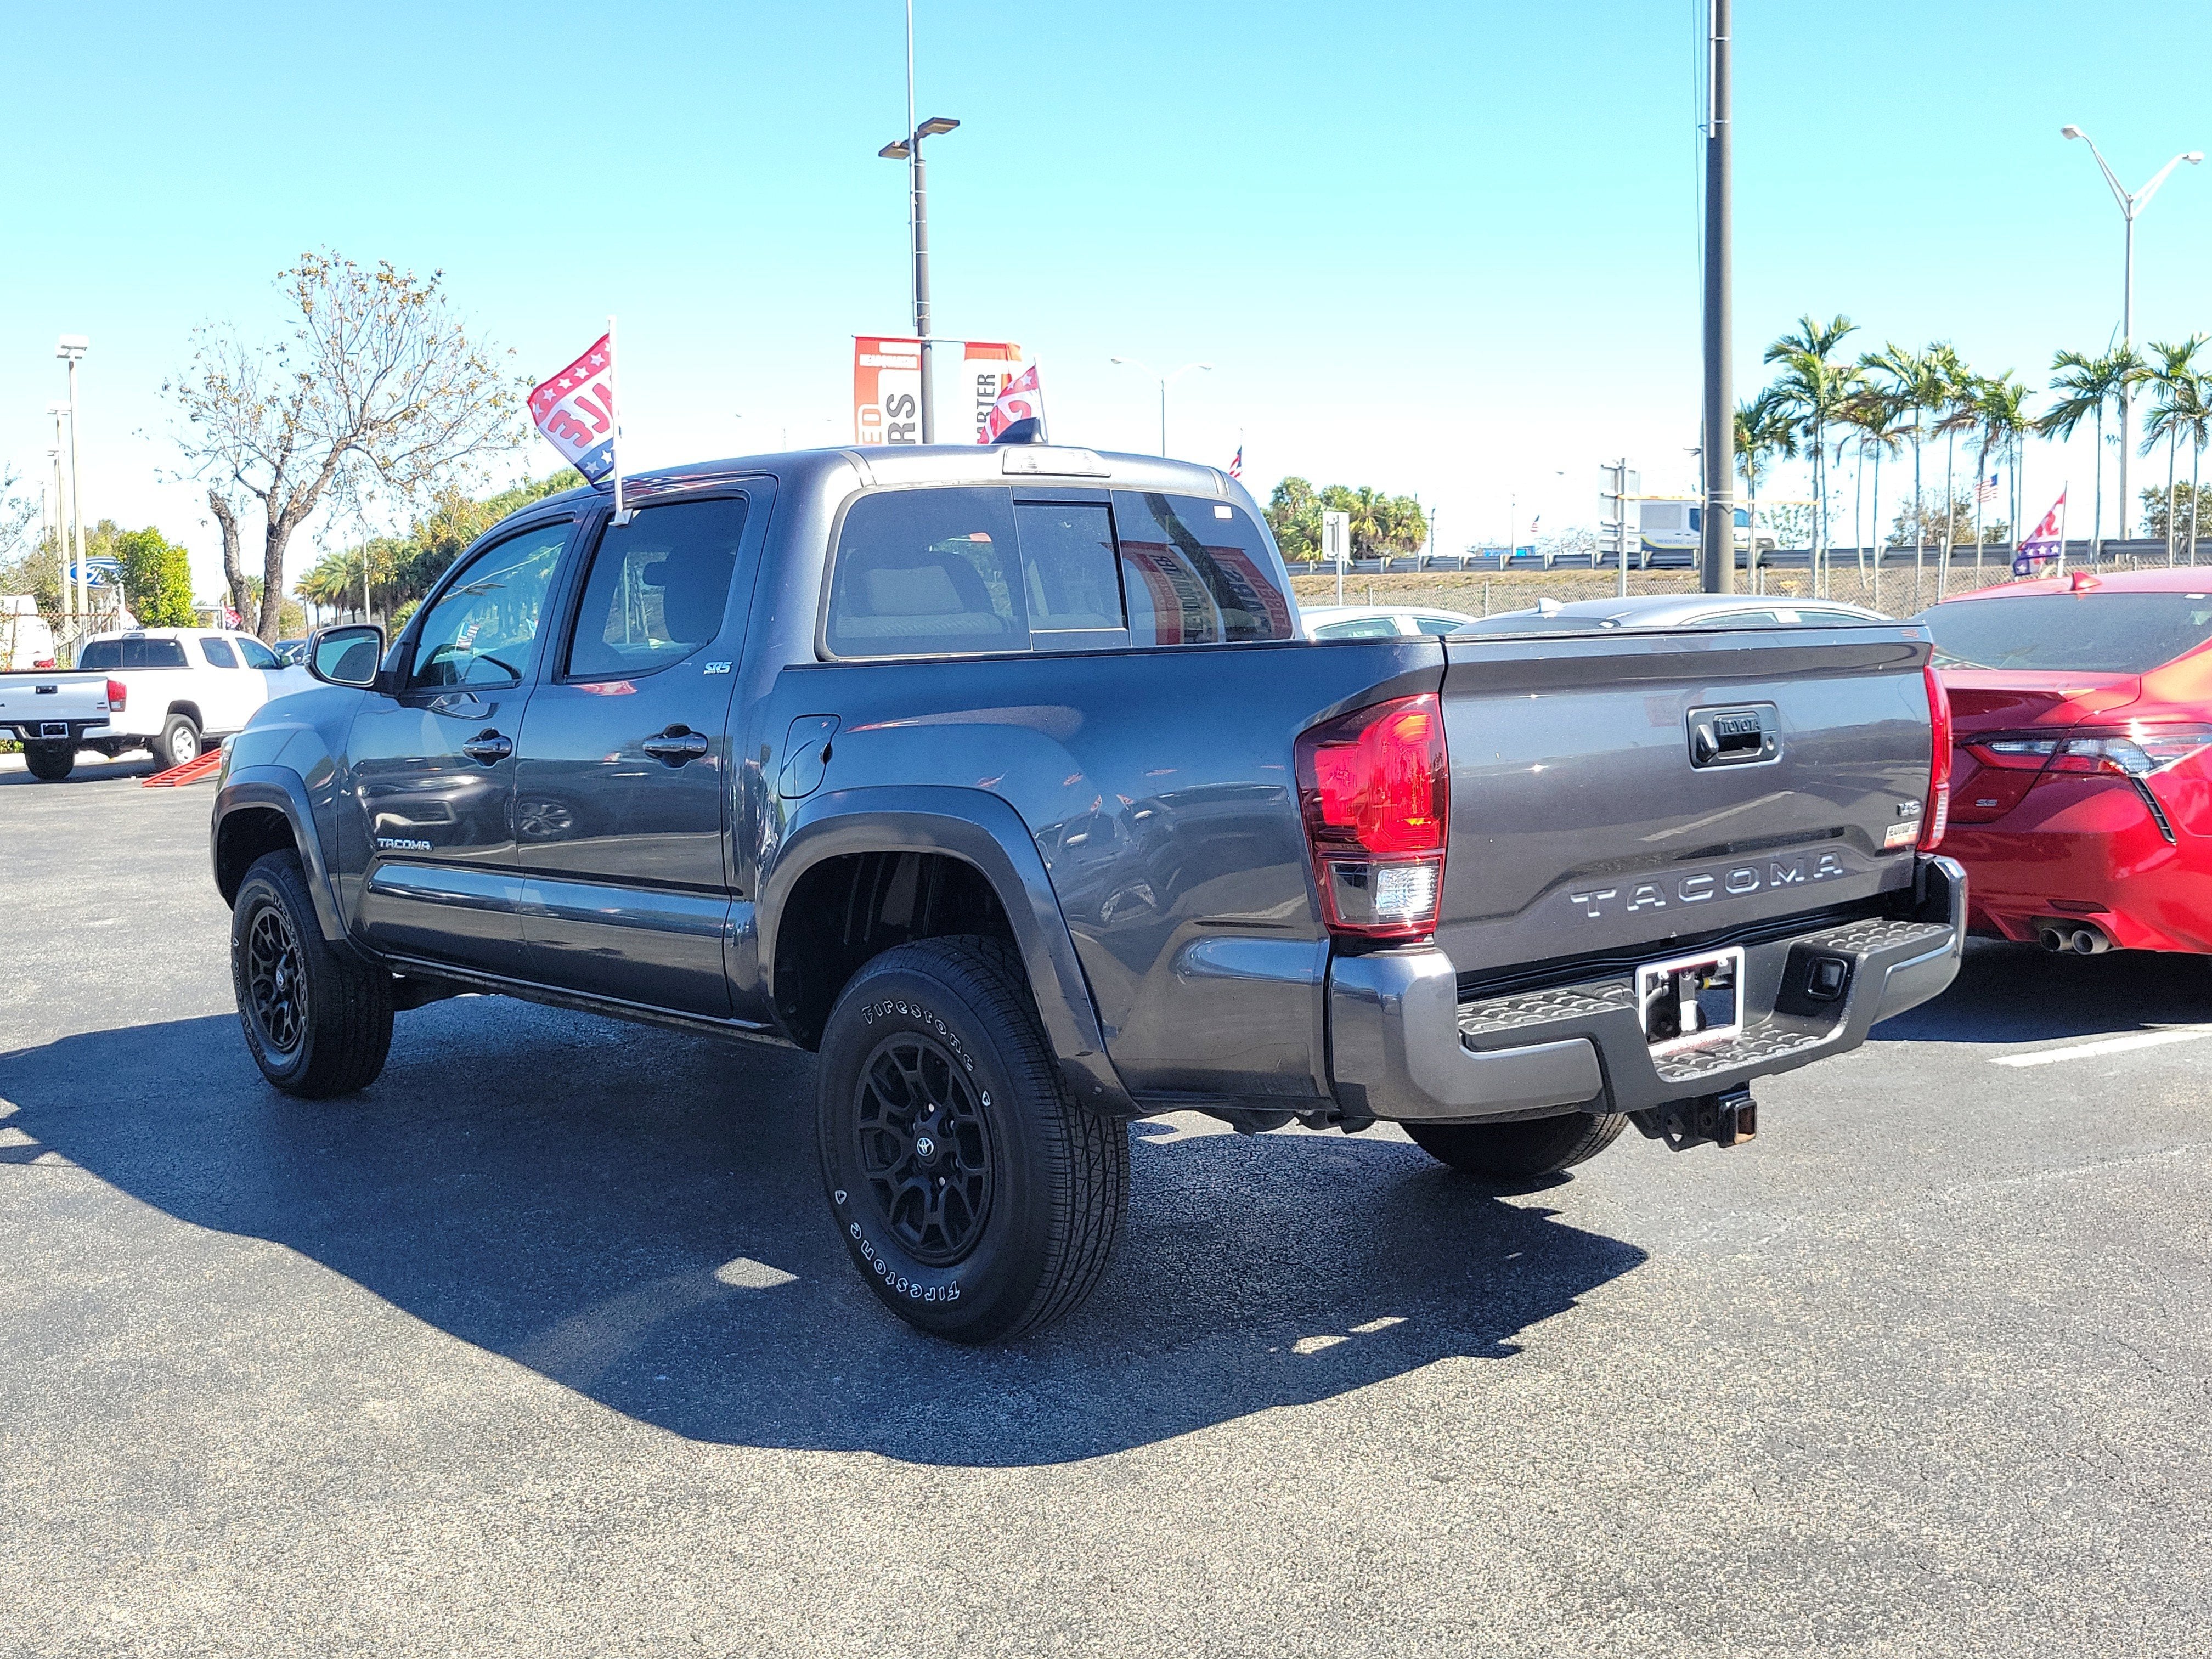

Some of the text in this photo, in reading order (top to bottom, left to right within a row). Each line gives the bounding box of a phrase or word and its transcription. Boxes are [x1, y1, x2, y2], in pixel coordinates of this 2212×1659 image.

[886, 394, 916, 445] RS
[703, 661, 733, 674] SR5
[1721, 718, 1760, 733] TOYOTA
[377, 838, 434, 851] TACOMA
[1570, 850, 1843, 917] TACOMA
[862, 1000, 973, 1071] Firestone
[850, 1222, 960, 1301] Firestone
